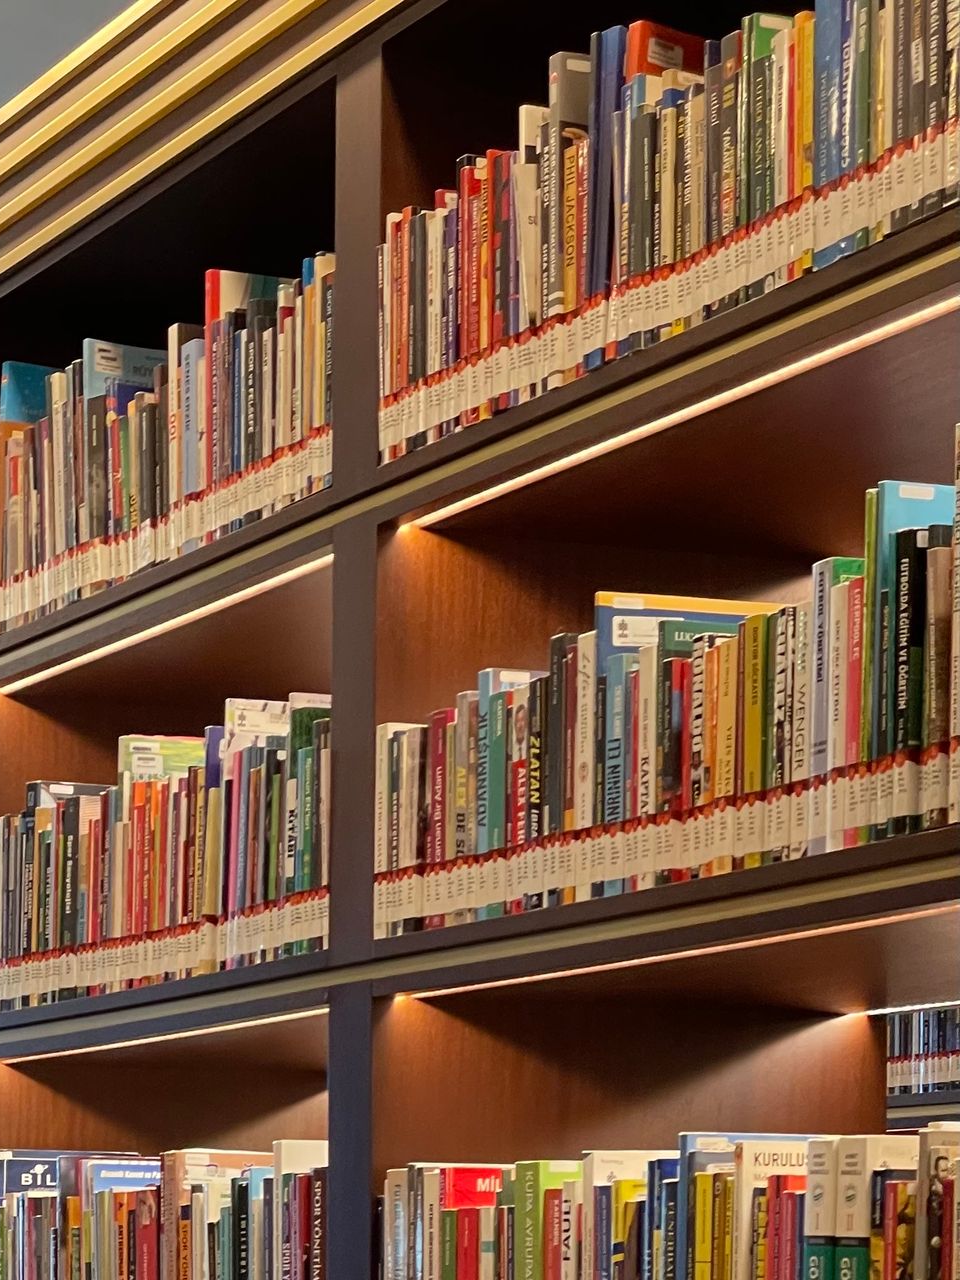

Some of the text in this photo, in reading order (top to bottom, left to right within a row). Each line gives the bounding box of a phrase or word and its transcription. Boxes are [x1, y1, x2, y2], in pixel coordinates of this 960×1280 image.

[754, 77, 764, 123] FUTBOL
[565, 156, 576, 268] PHIL JACKSON
[247, 374, 254, 385] ve
[816, 571, 825, 617] FUTBOL
[852, 588, 861, 660] LIVERPOOL FC
[898, 558, 910, 710] FUTBOLDA EĞİTİM VE ÖĞRETİM
[794, 683, 807, 771] WENGER
[434, 766, 442, 801] Adam
[477, 712, 489, 827] ADANMIŞLIK
[517, 767, 525, 806] ALEX
[530, 736, 539, 803] ZLATAN
[434, 803, 442, 820] Bir
[456, 766, 466, 836] ALEX DE
[65, 835, 73, 914] Spor Sosyolojisi
[312, 1180, 322, 1217] SPOR
[524, 1171, 534, 1212] KUPA
[181, 1223, 189, 1252] SPOR
[563, 1199, 571, 1261] FAUL!
[282, 1242, 291, 1271] SPOR
